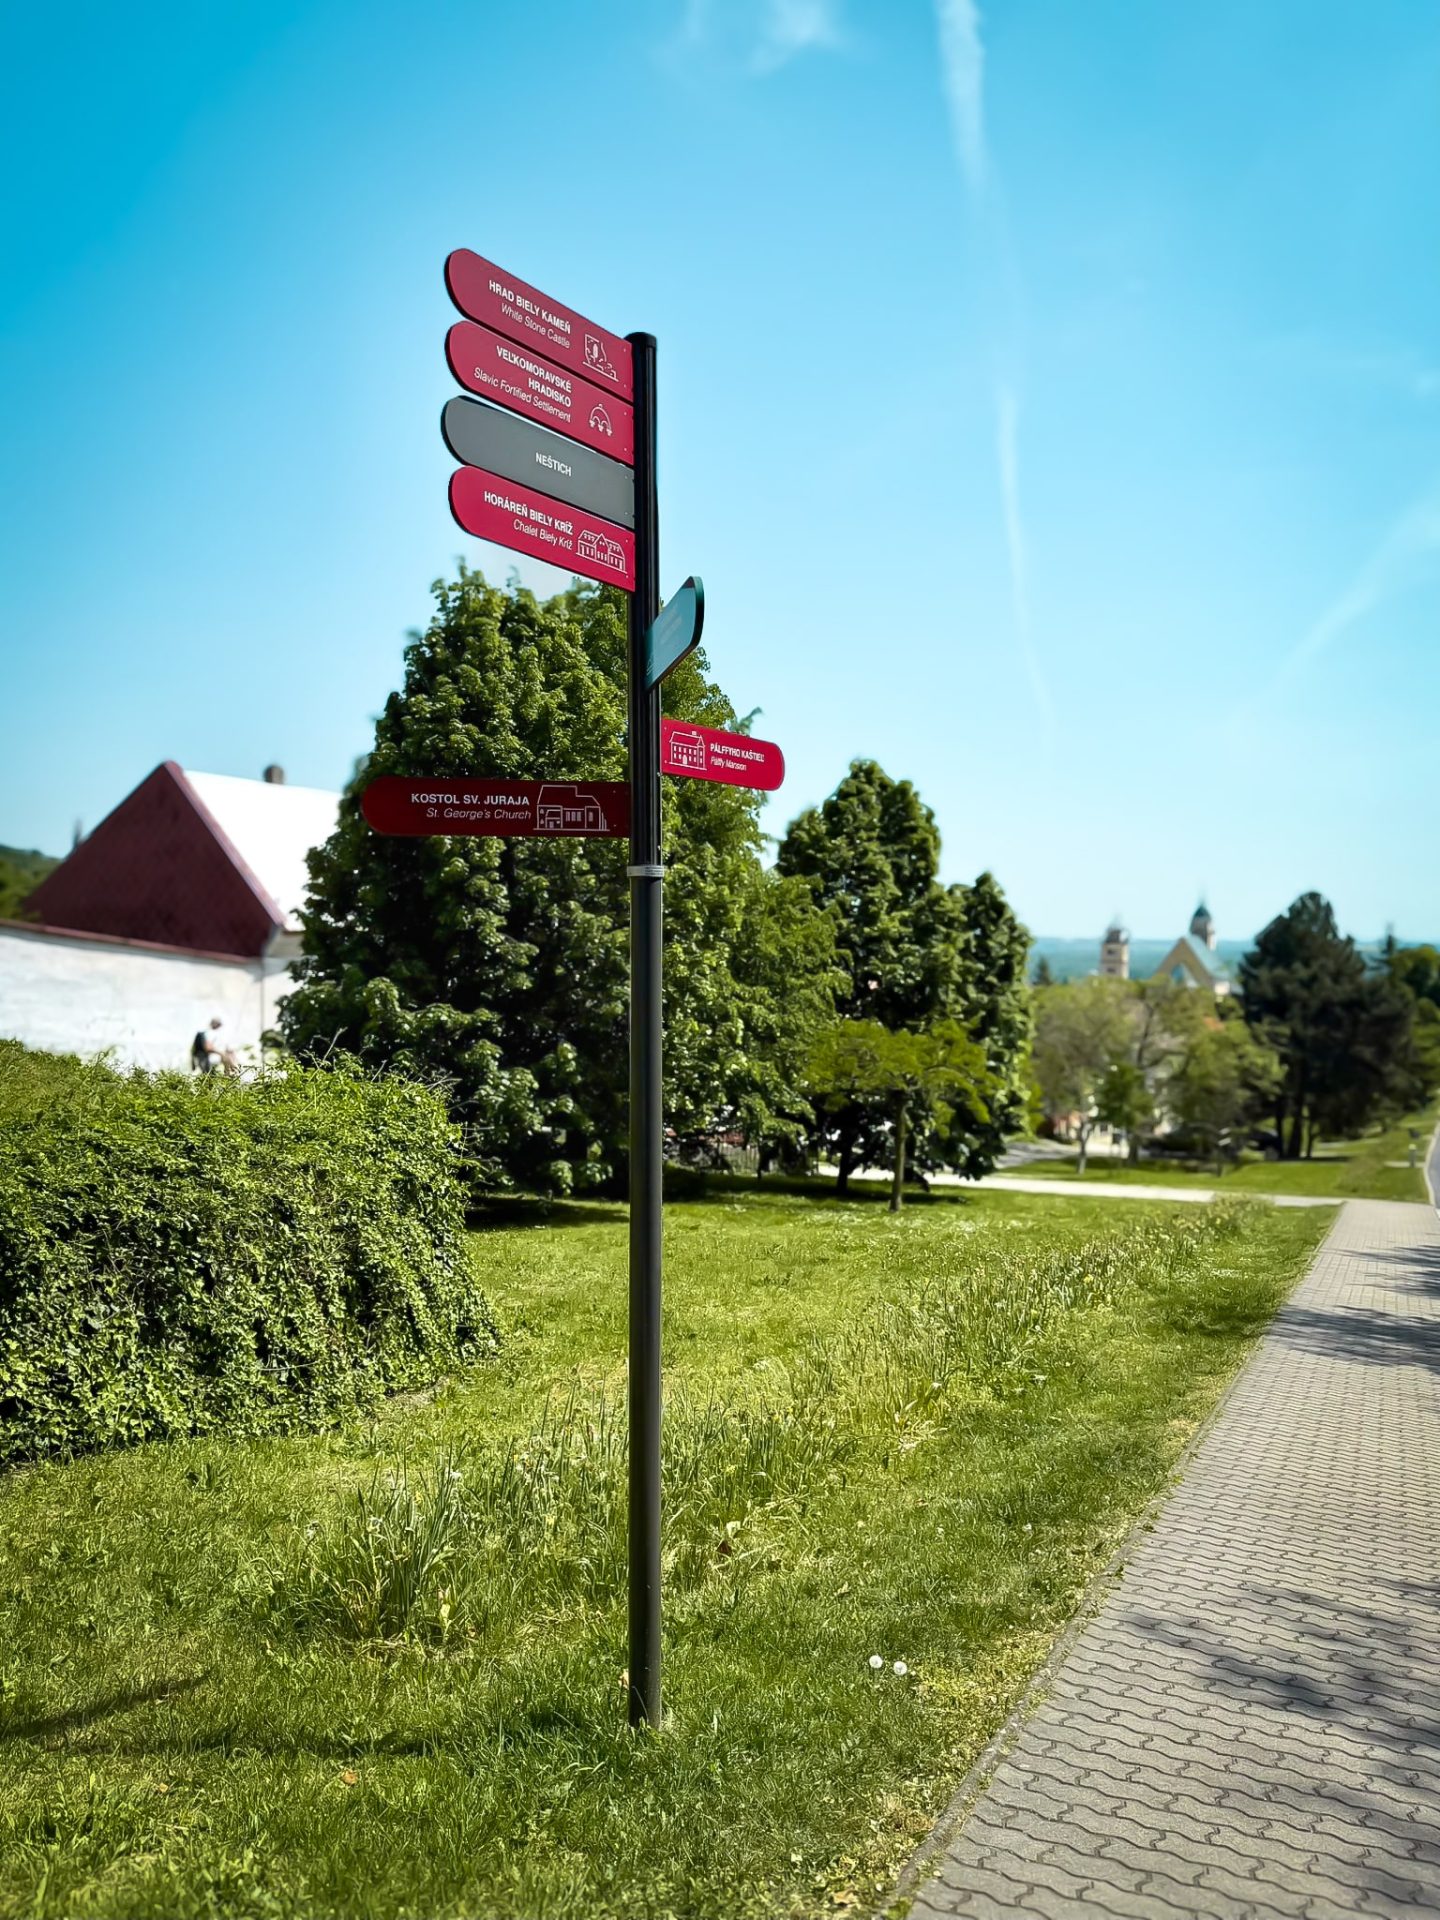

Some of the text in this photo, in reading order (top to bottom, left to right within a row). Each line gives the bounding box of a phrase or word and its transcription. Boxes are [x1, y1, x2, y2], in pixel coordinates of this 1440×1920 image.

[488, 280, 571, 334] HRAD BIELY KAMEŇ
[501, 303, 570, 349] White Stone Castle
[474, 367, 571, 423] Slavic Fortified Settlement
[528, 377, 572, 408] HRADISKO
[535, 452, 572, 477] NEŠTICH
[484, 491, 573, 536] HORÁREŇ BIELY KRÍŽ
[513, 519, 538, 538] Chalet
[539, 528, 558, 546] Biely
[411, 793, 530, 806] KOSTOL SV. JURAJA
[426, 807, 532, 820] St. George's Church
